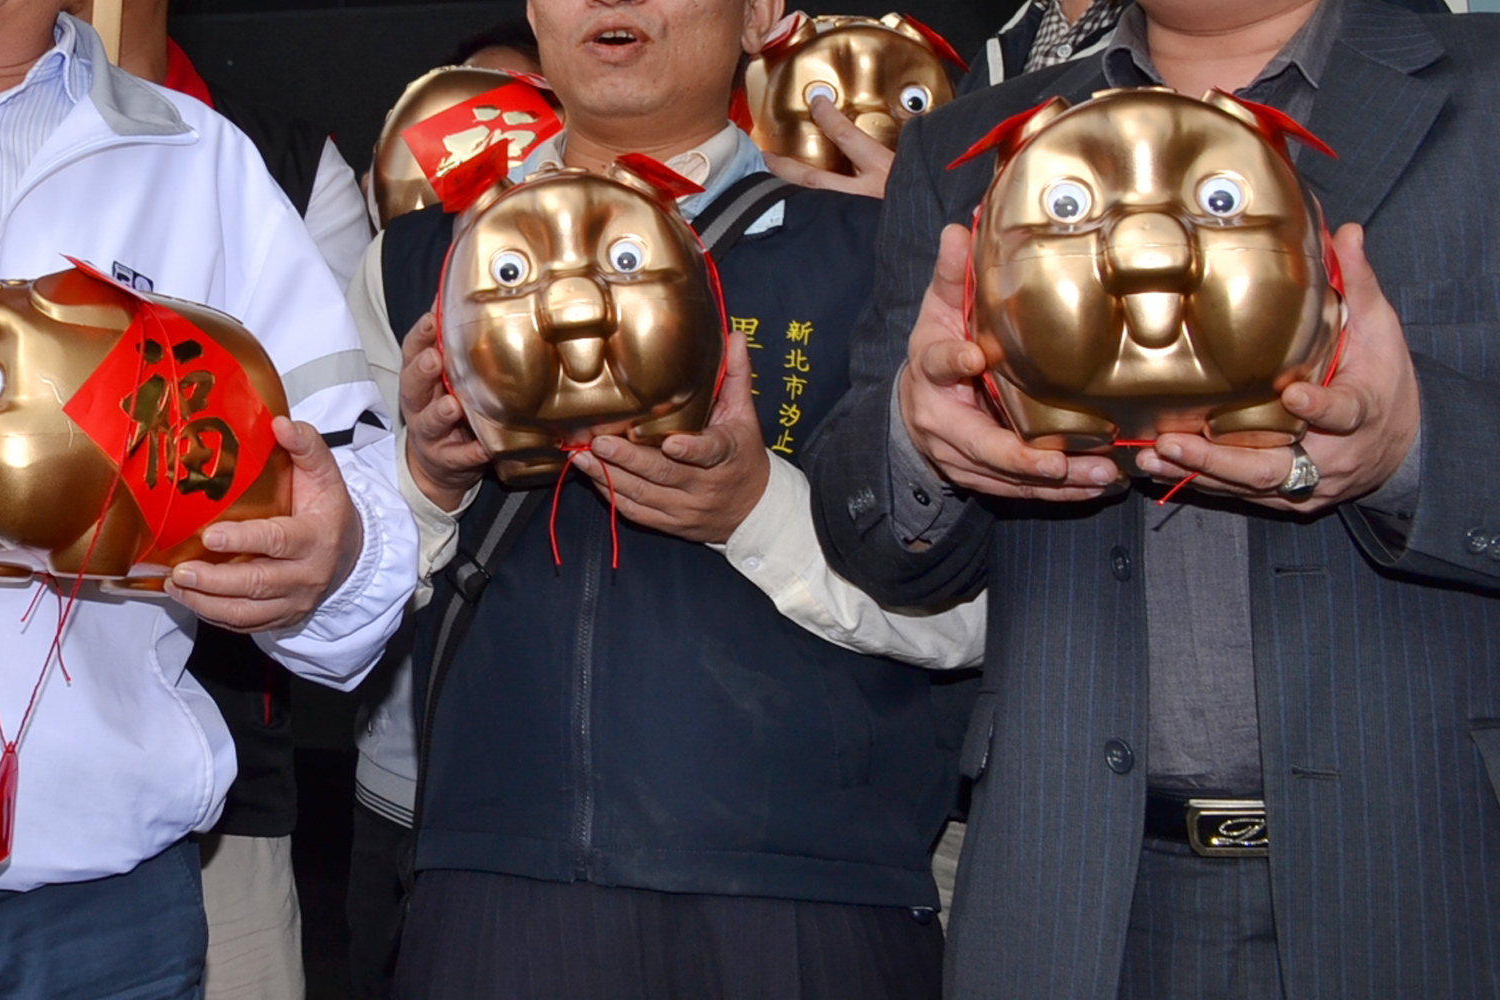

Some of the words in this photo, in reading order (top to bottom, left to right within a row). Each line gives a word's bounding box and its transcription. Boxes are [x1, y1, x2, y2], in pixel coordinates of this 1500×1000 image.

[119, 338, 241, 501] 福
[771, 320, 814, 454] 新北市汐止
